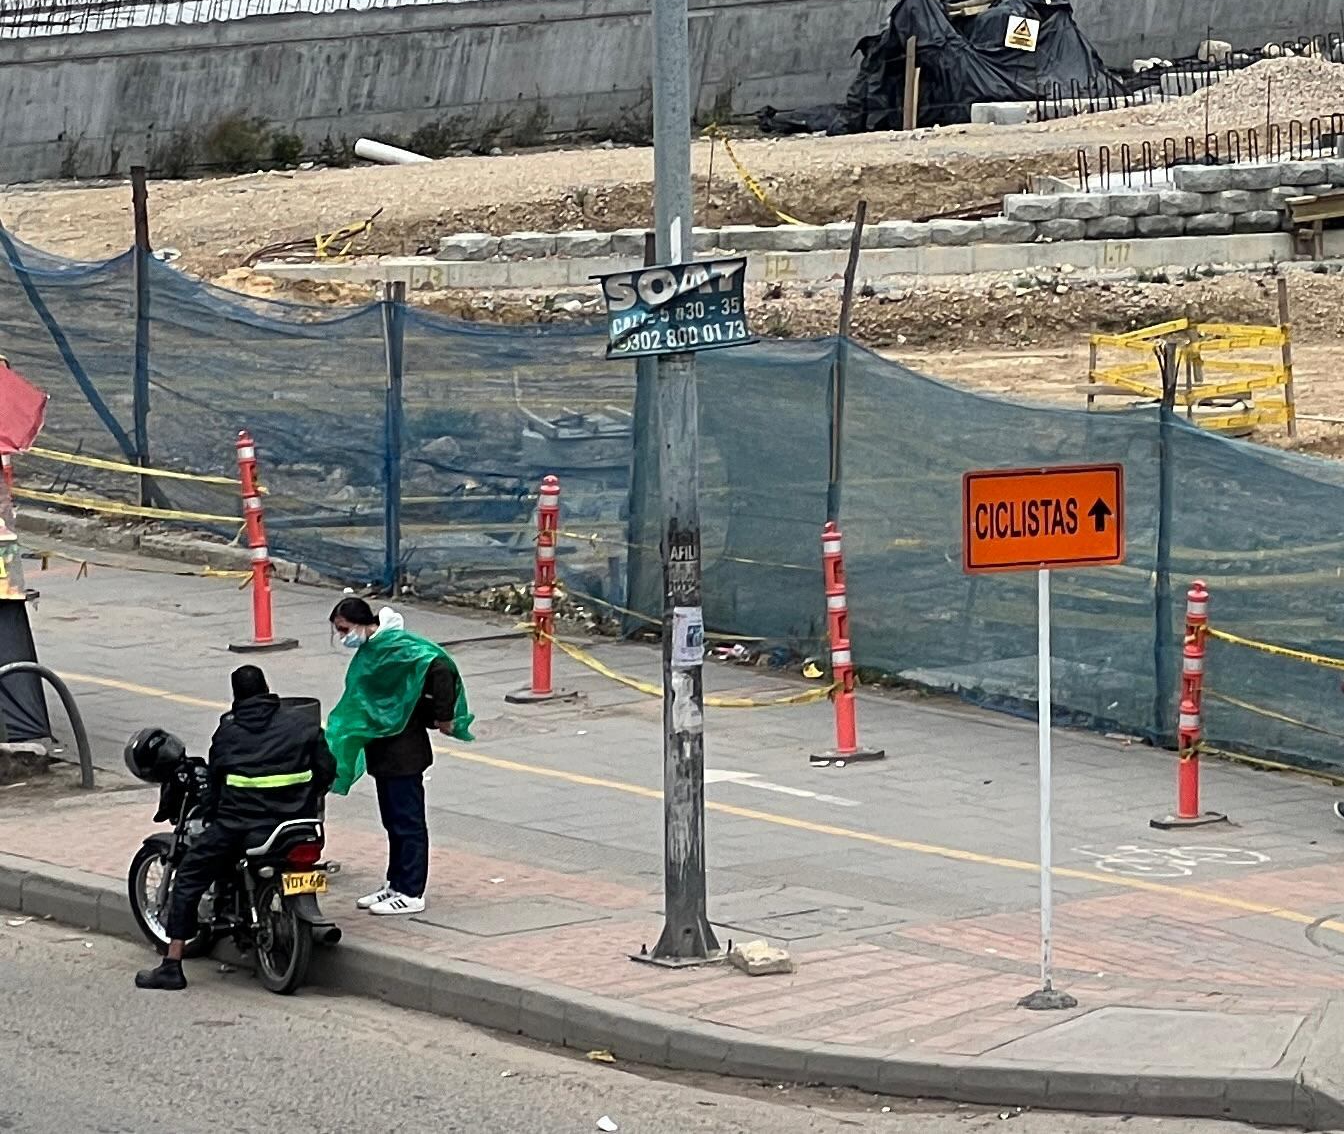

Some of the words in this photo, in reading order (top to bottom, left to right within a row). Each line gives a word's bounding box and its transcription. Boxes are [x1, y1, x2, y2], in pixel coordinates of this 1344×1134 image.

[605, 262, 745, 312] SOAT
[630, 331, 662, 352] 302
[975, 497, 1079, 540] CICLISTAS
